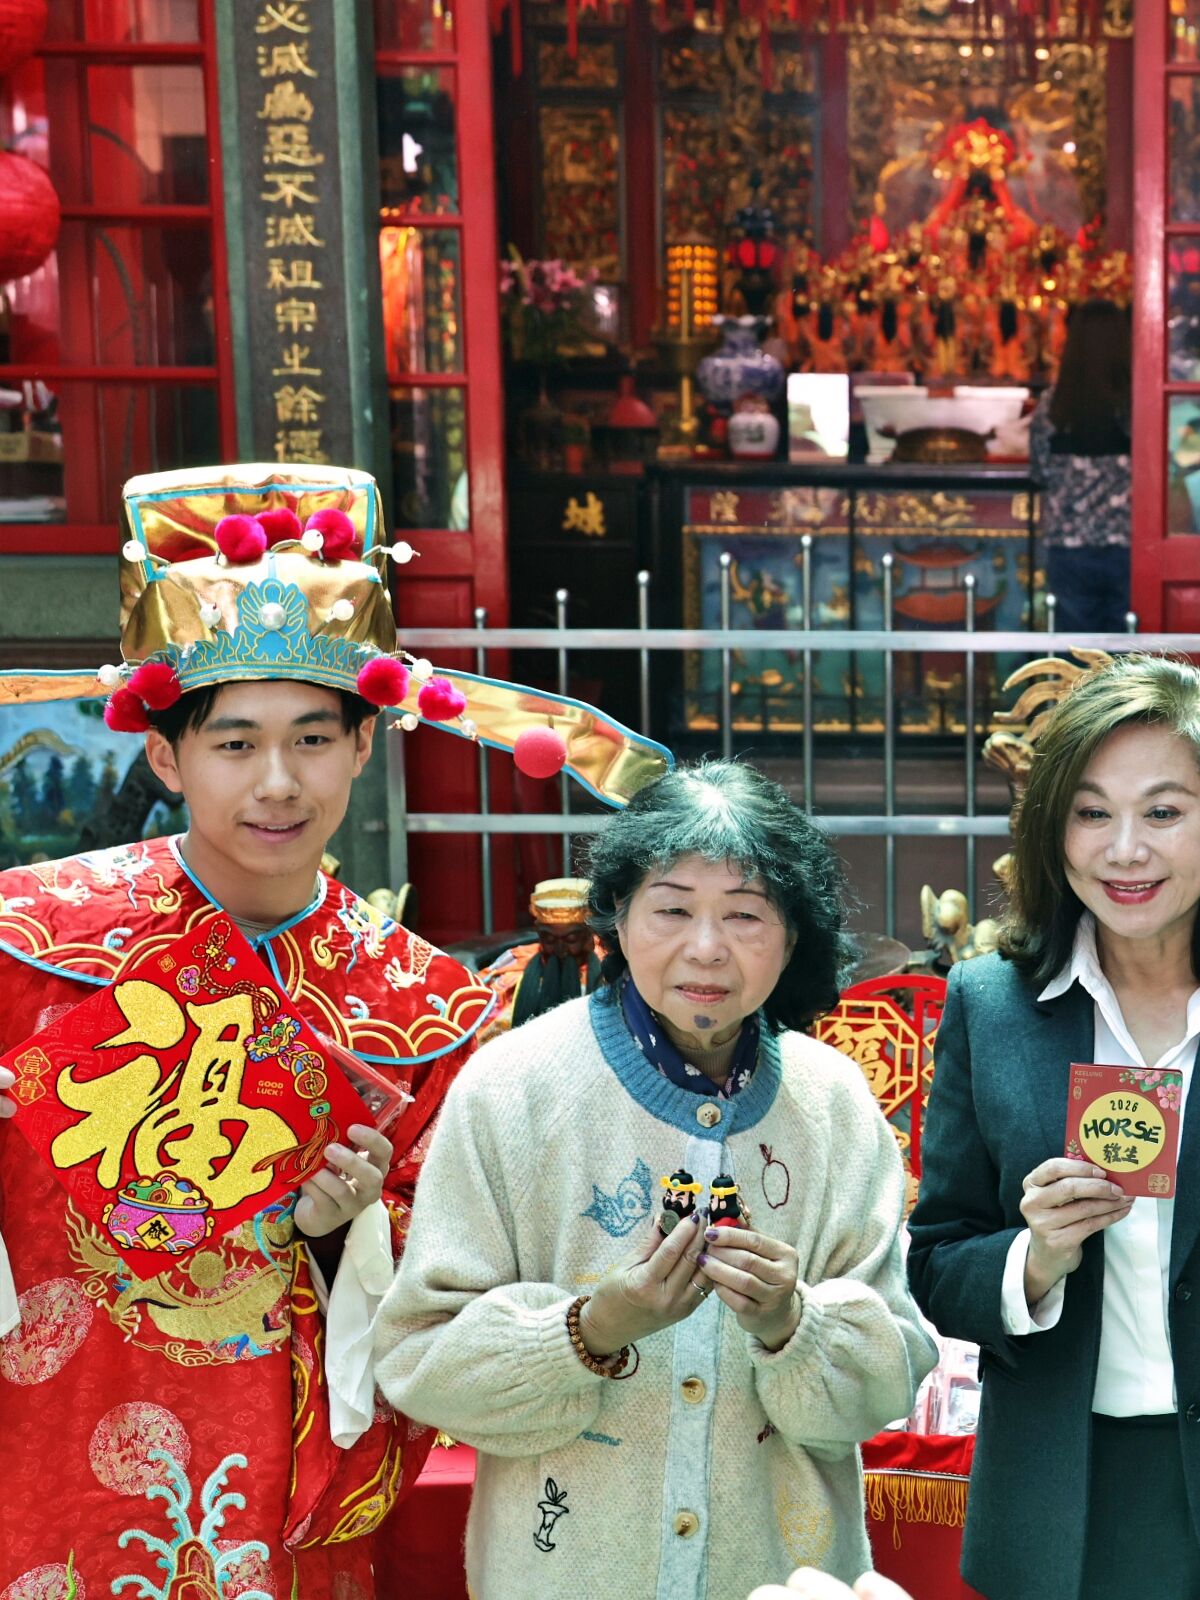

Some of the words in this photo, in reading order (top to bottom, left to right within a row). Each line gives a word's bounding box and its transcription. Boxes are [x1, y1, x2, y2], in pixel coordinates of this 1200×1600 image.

[18, 1053, 45, 1101] 富貴
[258, 1080, 284, 1089] GOOD
[50, 979, 300, 1211] 福
[1110, 1099, 1139, 1112] 2026
[1083, 1117, 1162, 1144] HORSE
